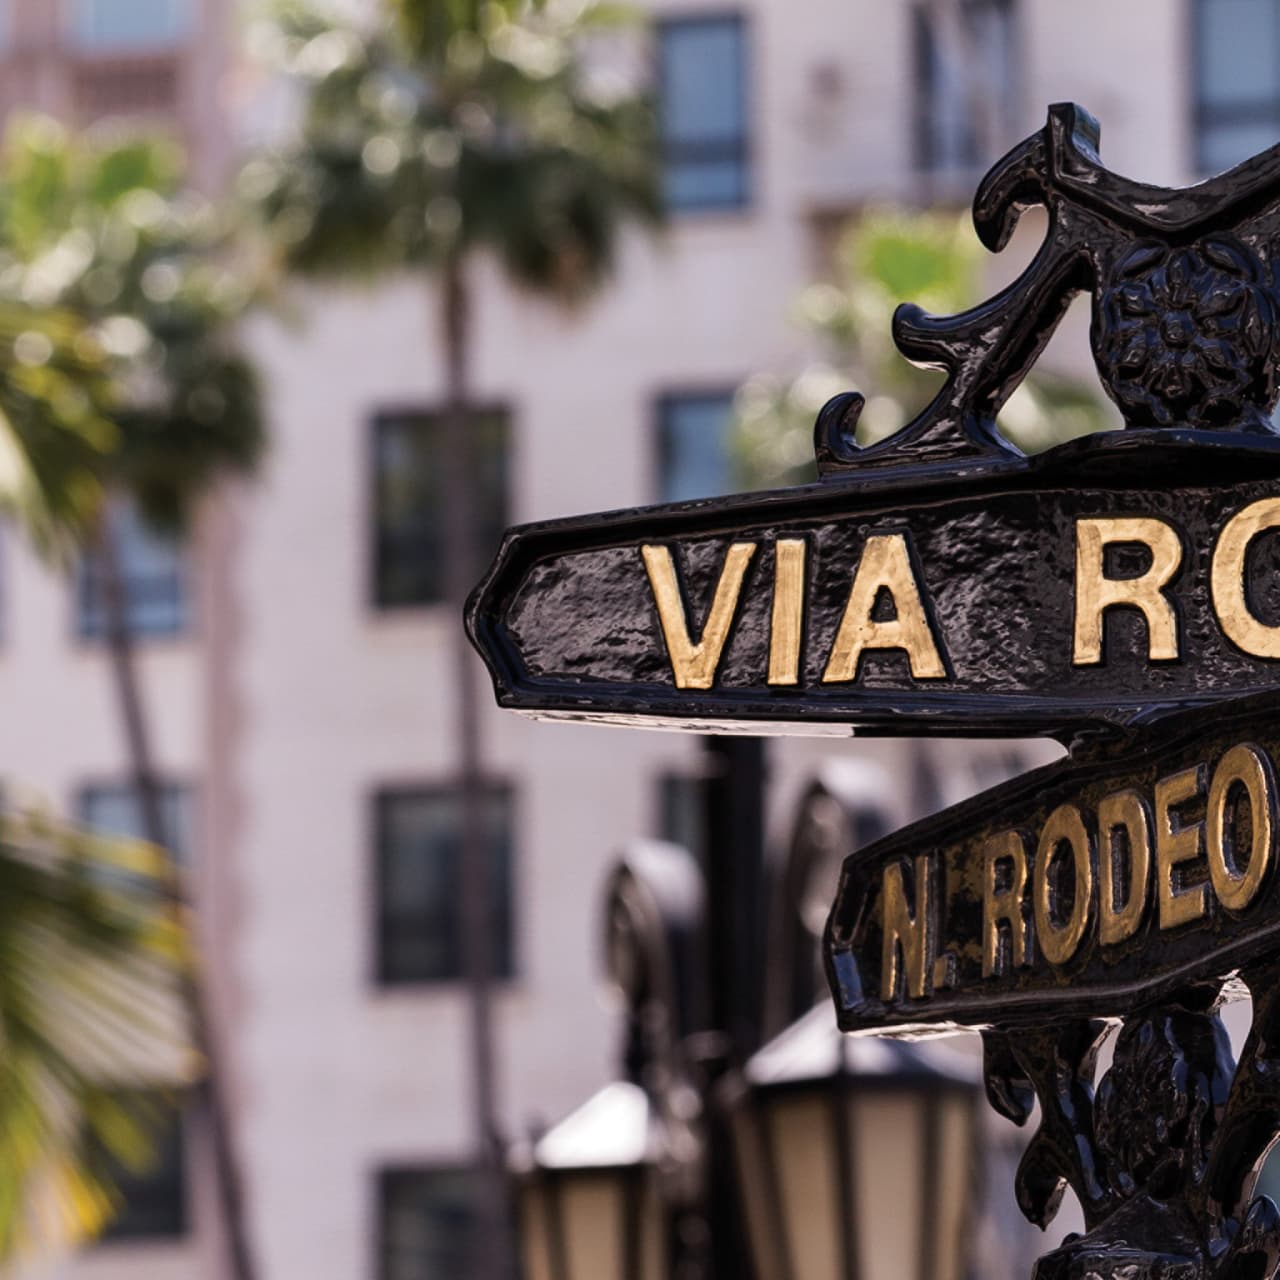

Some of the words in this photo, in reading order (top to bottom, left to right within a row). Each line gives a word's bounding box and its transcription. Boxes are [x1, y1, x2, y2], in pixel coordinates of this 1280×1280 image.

[639, 532, 947, 690] VIA
[879, 854, 954, 1000] N.
[981, 741, 1279, 979] RODEO
